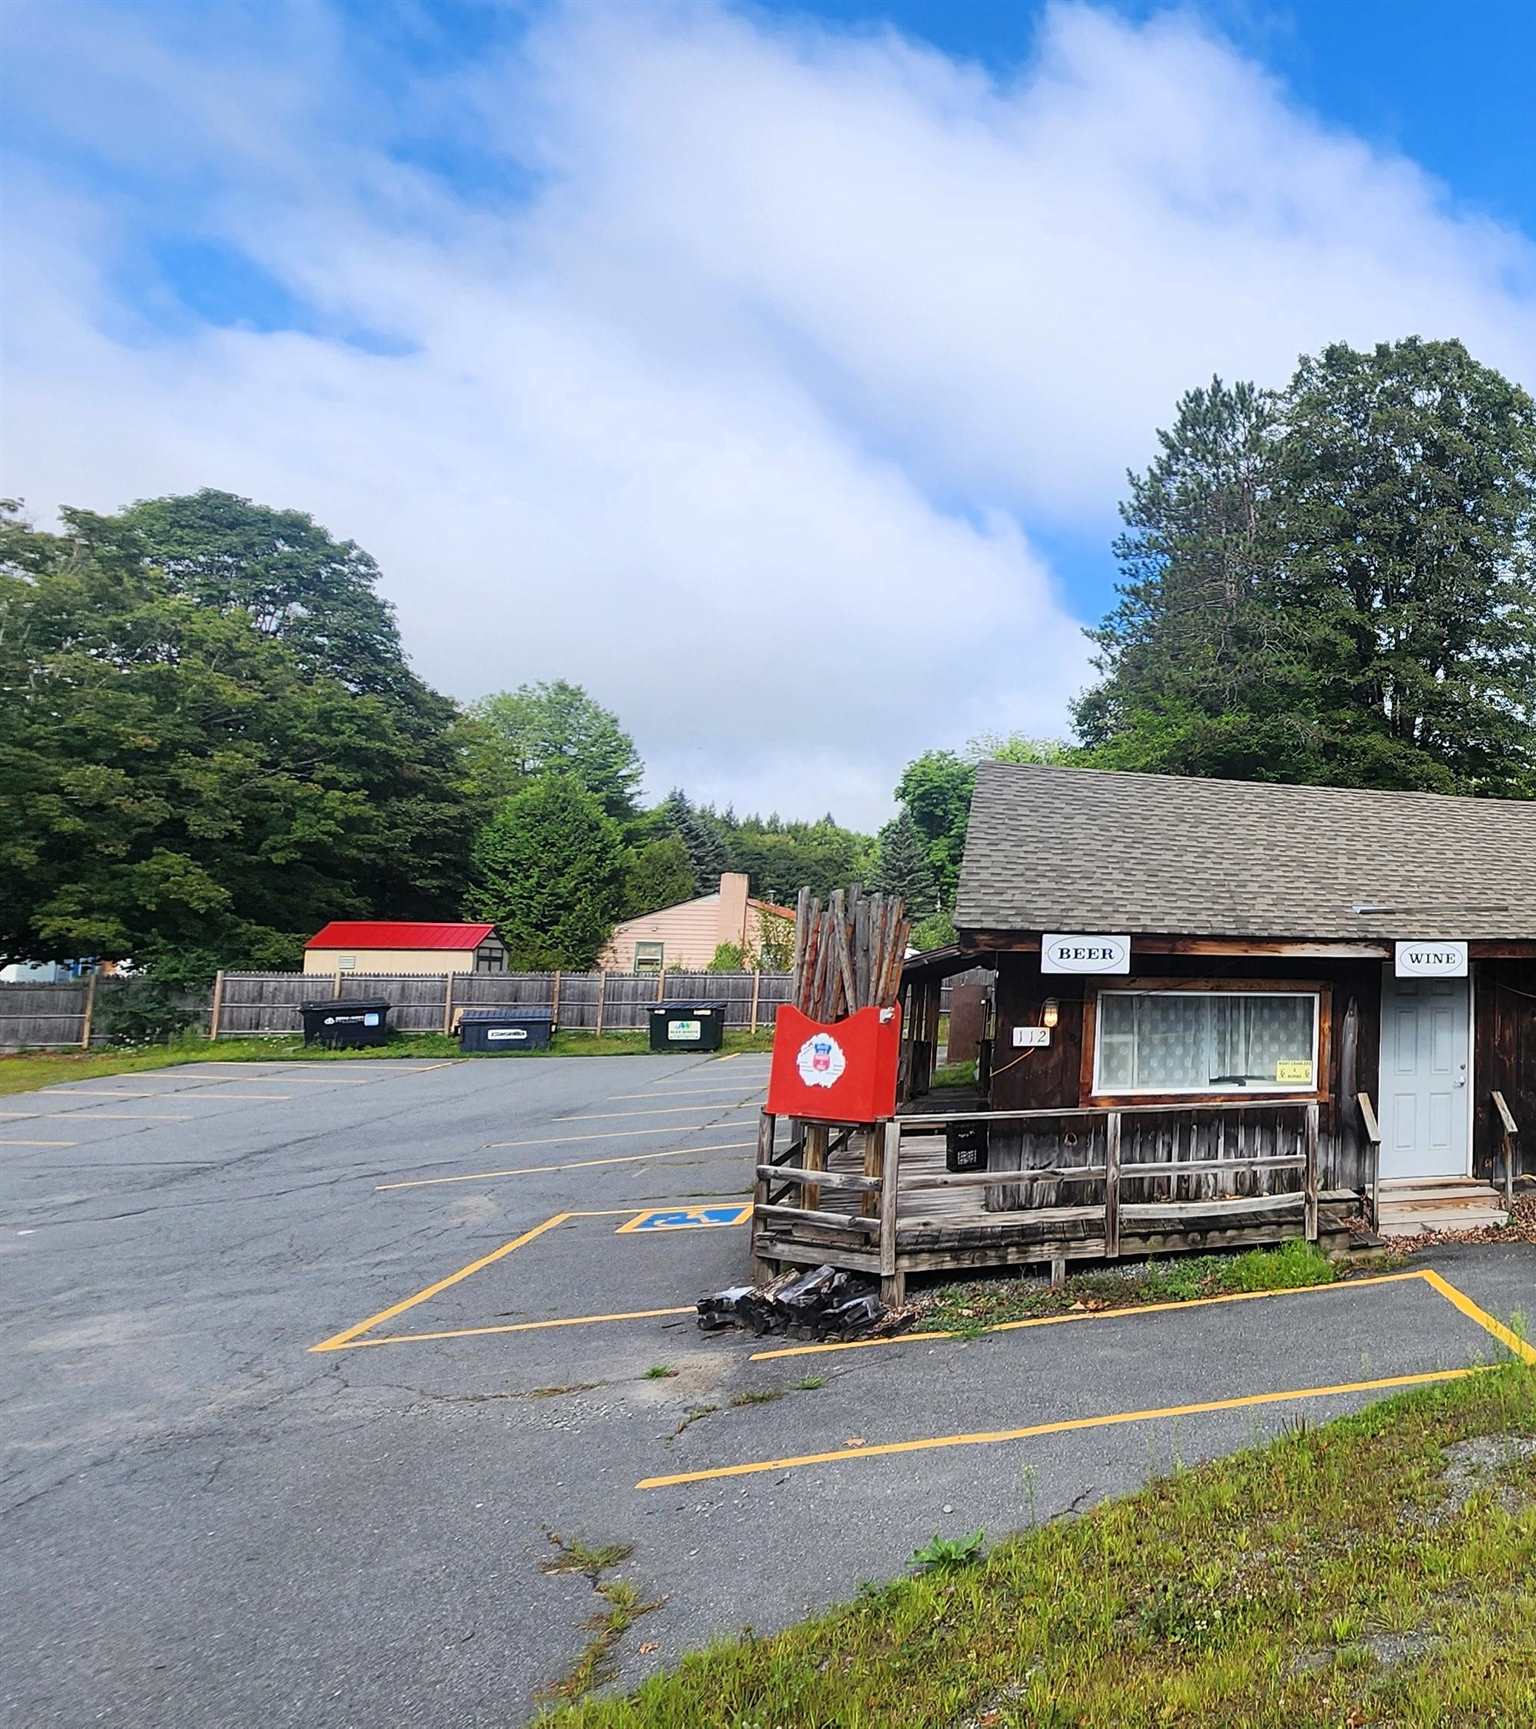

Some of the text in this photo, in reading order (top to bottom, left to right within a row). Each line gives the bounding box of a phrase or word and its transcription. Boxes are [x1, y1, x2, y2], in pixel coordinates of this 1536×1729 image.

[1058, 947, 1114, 960] BEER
[1408, 953, 1456, 964] WINE
[1018, 1030, 1047, 1044] 112
